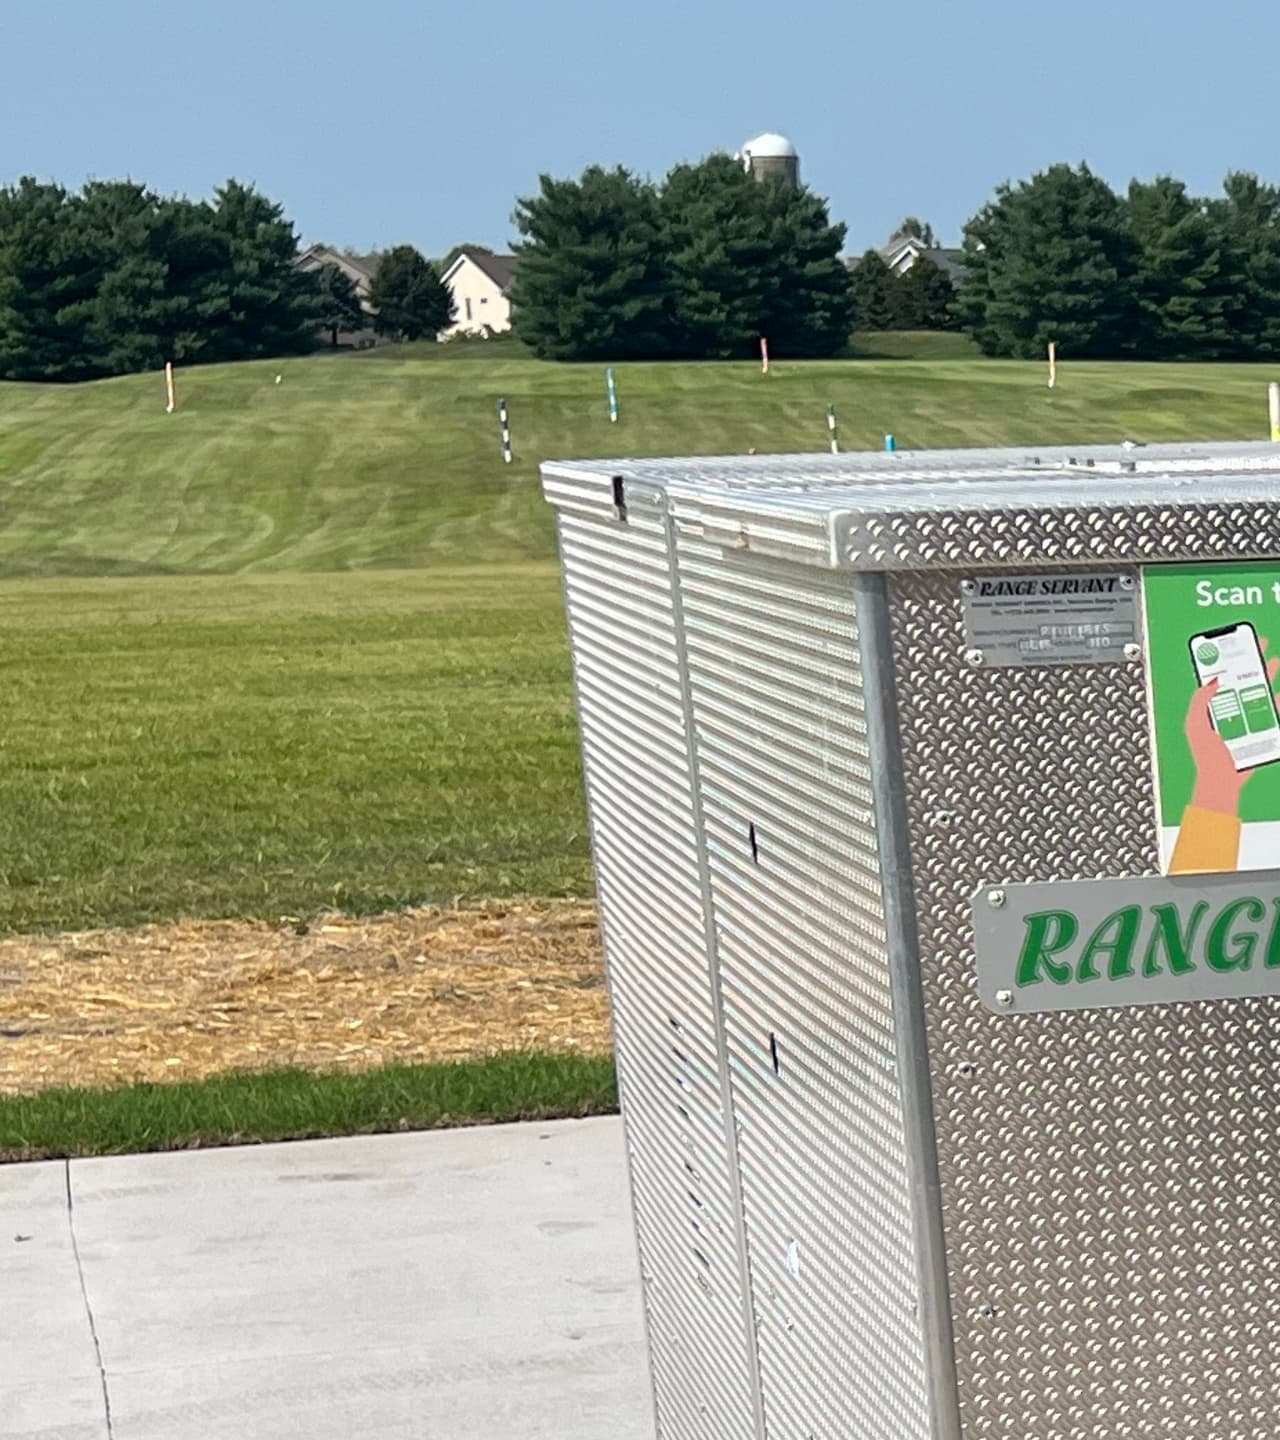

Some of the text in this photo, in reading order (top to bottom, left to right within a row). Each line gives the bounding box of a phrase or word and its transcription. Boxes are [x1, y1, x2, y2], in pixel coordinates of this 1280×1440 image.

[980, 577, 1119, 597] RANGE SERVANT
[1196, 580, 1263, 606] Scan
